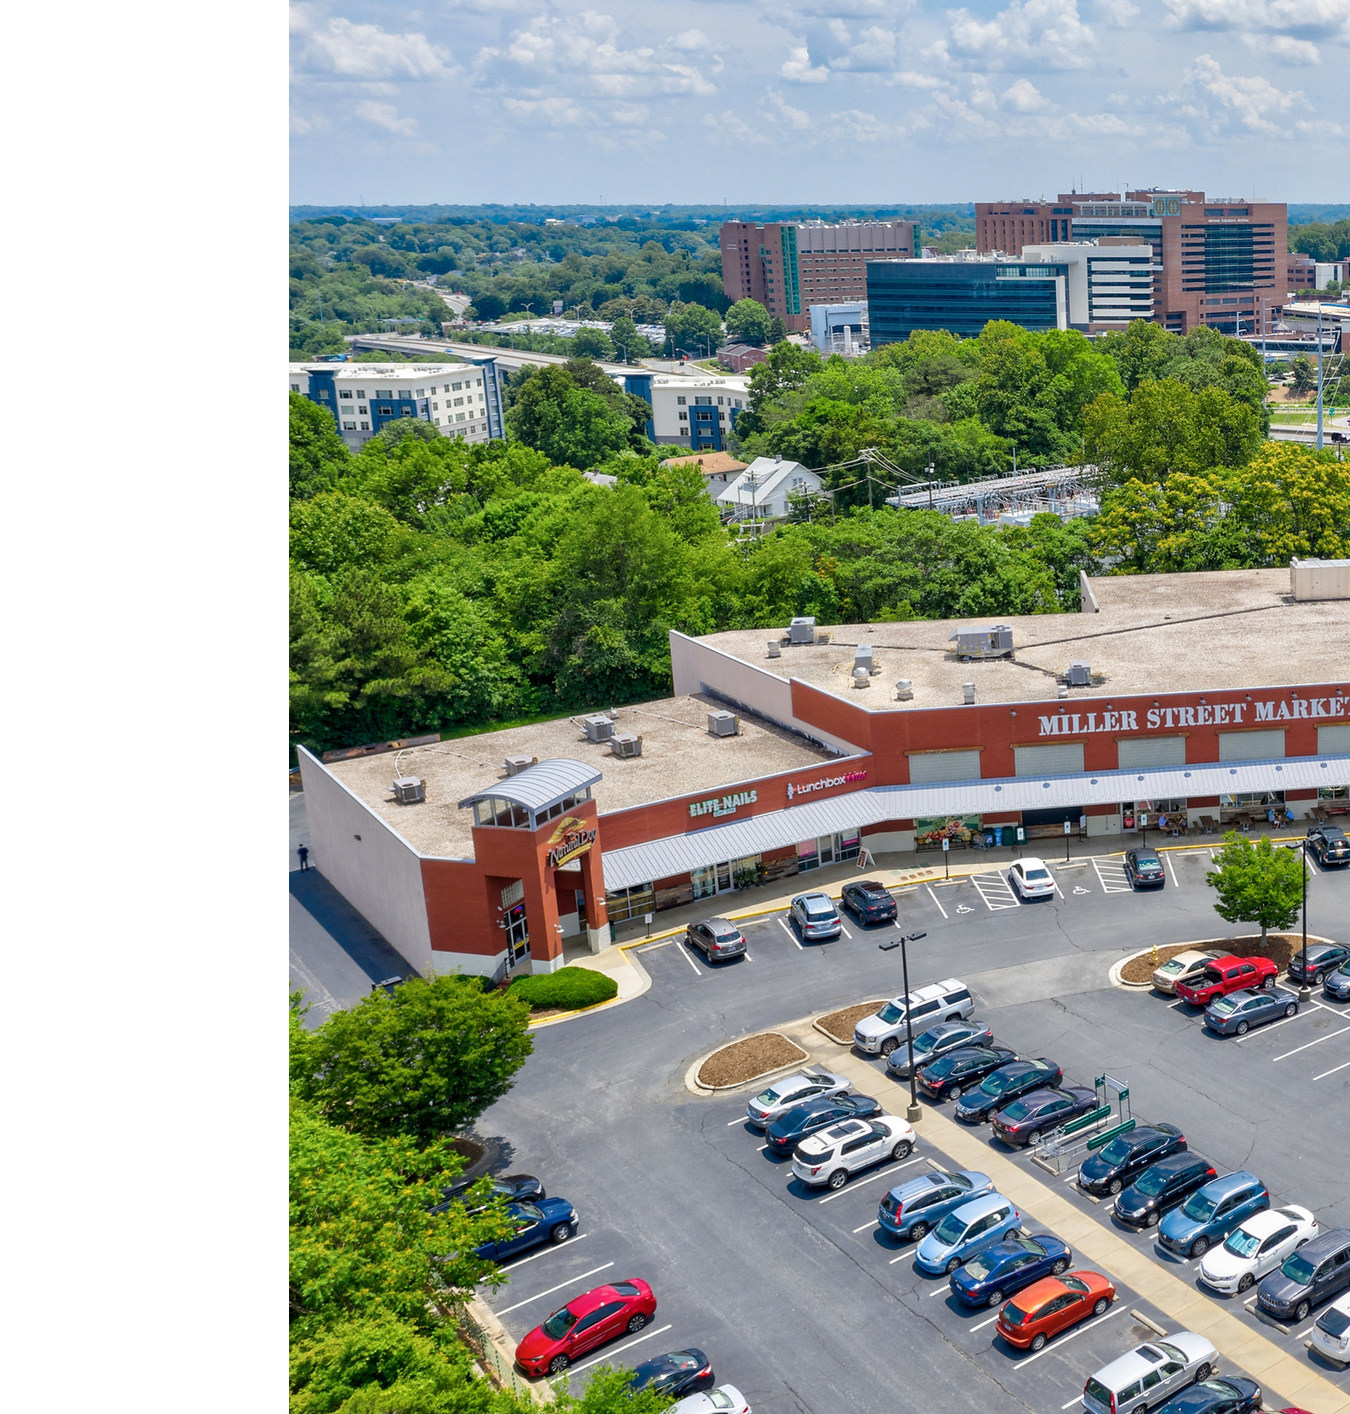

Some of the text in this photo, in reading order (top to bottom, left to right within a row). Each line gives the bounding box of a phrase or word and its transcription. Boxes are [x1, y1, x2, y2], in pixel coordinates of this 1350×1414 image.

[1038, 710, 1139, 736] MILLER
[1147, 703, 1247, 729] STREET
[689, 798, 720, 817] ELITE
[722, 789, 758, 809] NAILS
